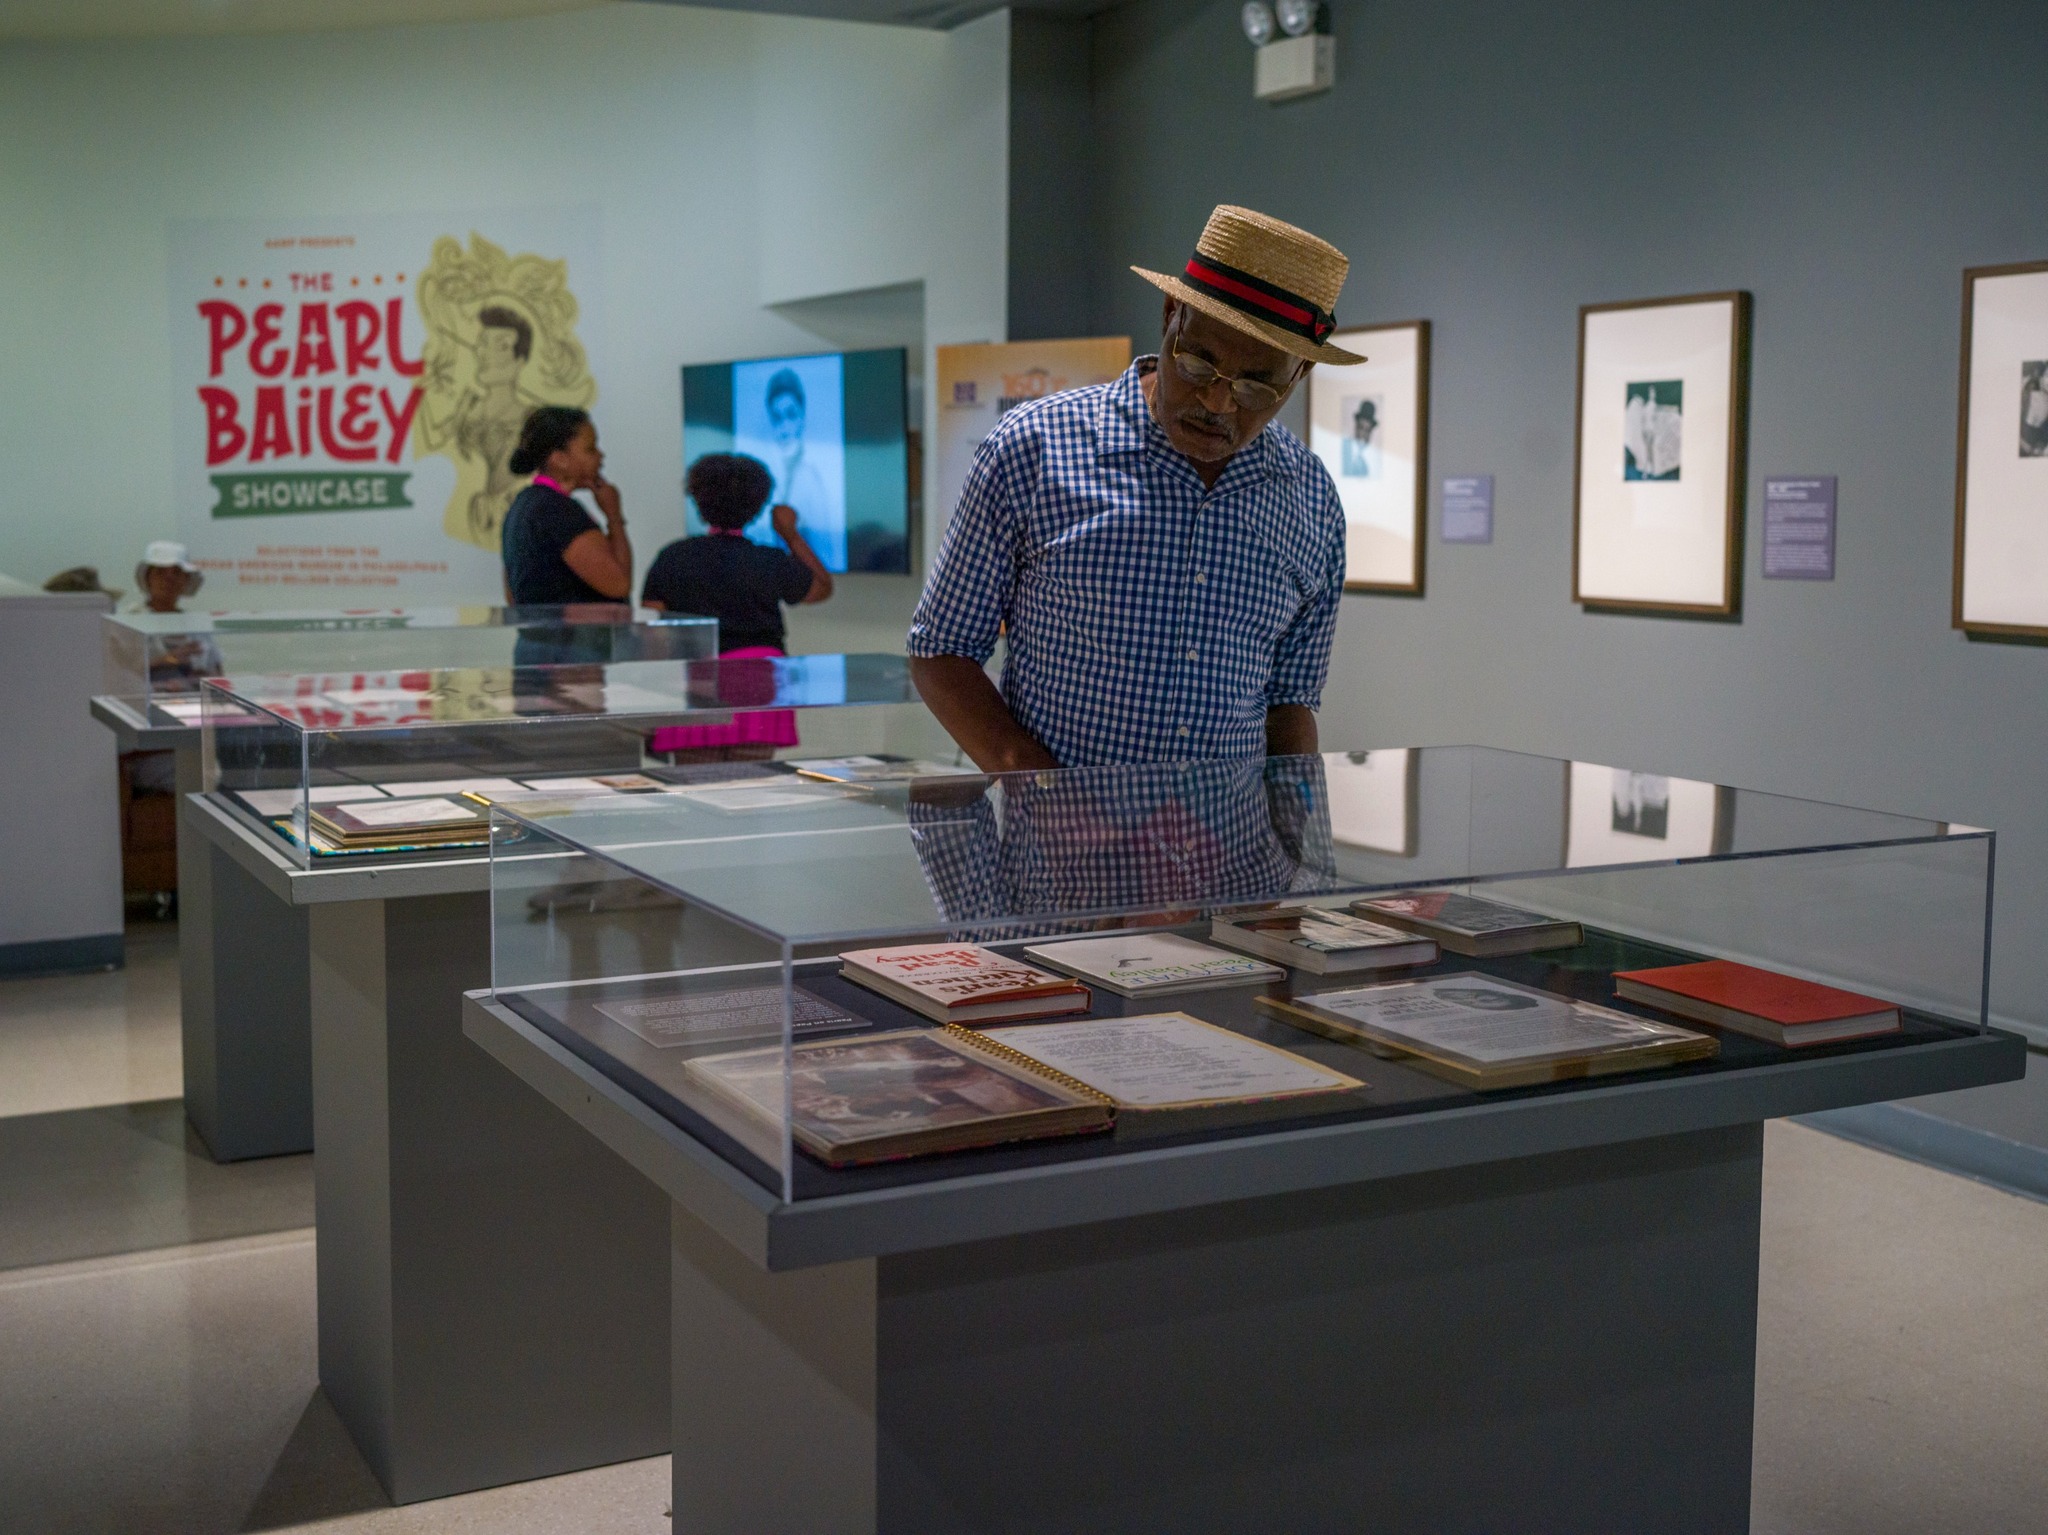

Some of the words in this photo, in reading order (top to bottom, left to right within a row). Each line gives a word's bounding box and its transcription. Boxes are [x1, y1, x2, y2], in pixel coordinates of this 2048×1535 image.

[290, 273, 334, 292] THE
[197, 296, 426, 378] PEARL
[232, 477, 389, 508] SHOWCASE
[876, 950, 980, 964] Bailey
[897, 957, 988, 972] Pearl
[1190, 957, 1254, 970] Pearl
[912, 969, 1046, 986] Kitchen
[1110, 965, 1188, 978] Bailey
[939, 977, 1041, 995] Pearl's
